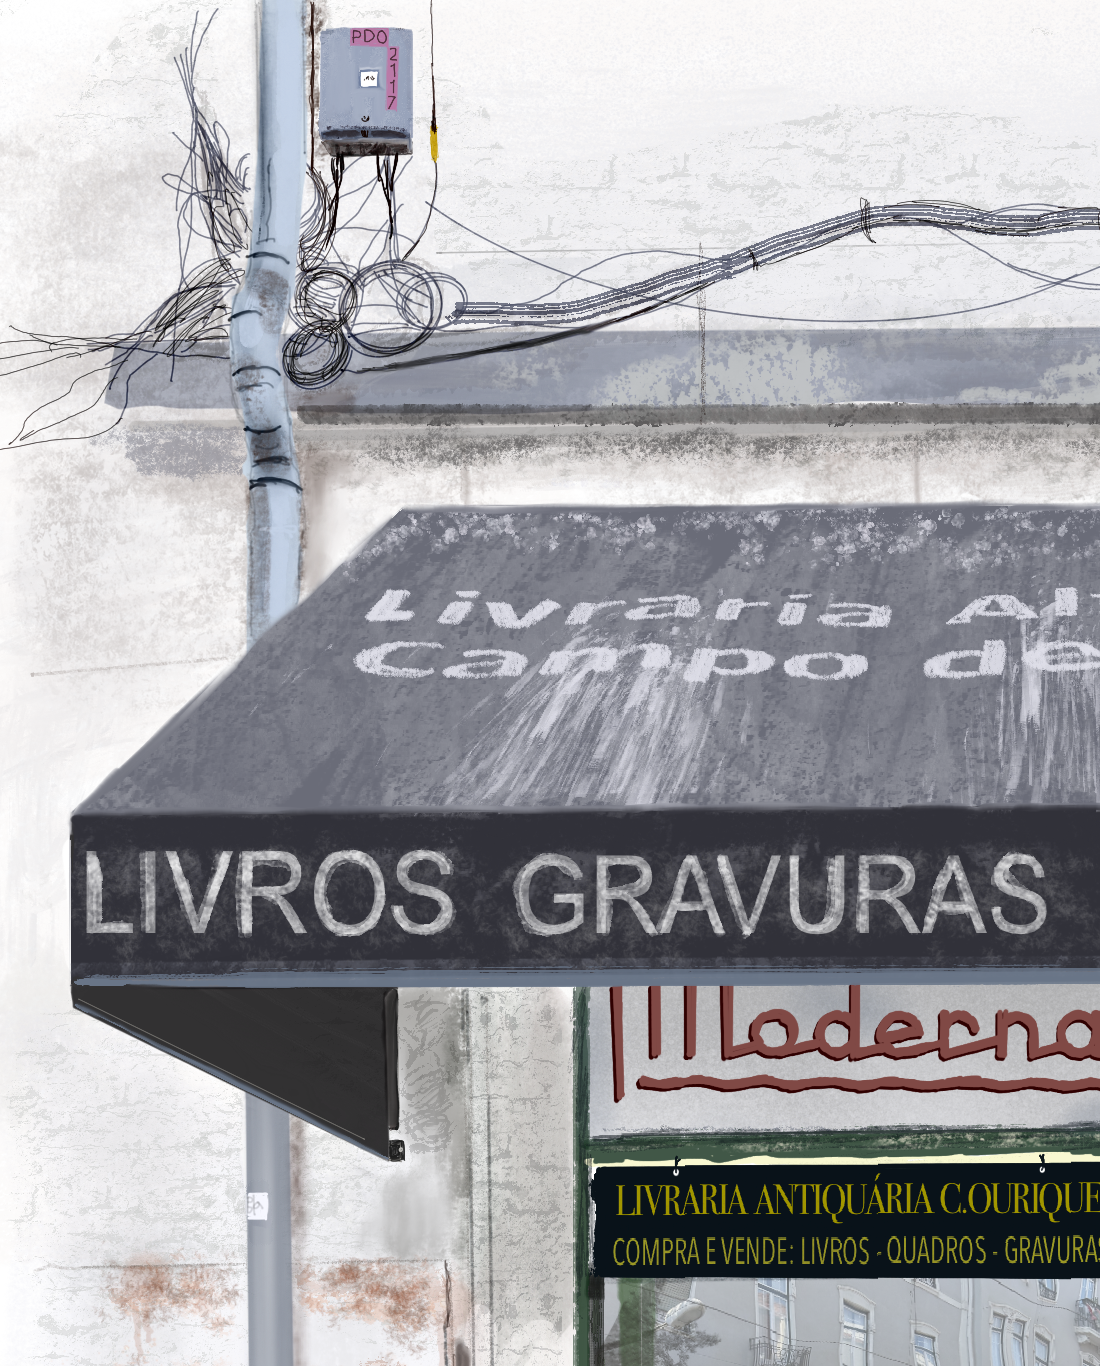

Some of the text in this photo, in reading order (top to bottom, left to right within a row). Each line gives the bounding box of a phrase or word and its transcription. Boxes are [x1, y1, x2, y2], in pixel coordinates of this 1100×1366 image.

[364, 588, 892, 629] Livraria
[353, 640, 869, 683] Campo
[84, 848, 455, 938] LIVROS
[513, 850, 1049, 938] GRAVURAS
[616, 1183, 749, 1216] LIVRARIA
[753, 1173, 935, 1224] ANTIQUÁRIA
[613, 1237, 700, 1266] COMPRA
[706, 1237, 716, 1265] E
[721, 1236, 794, 1265] VENDE:
[801, 1236, 870, 1265] LIVROS
[887, 1235, 987, 1264] QUADROS
